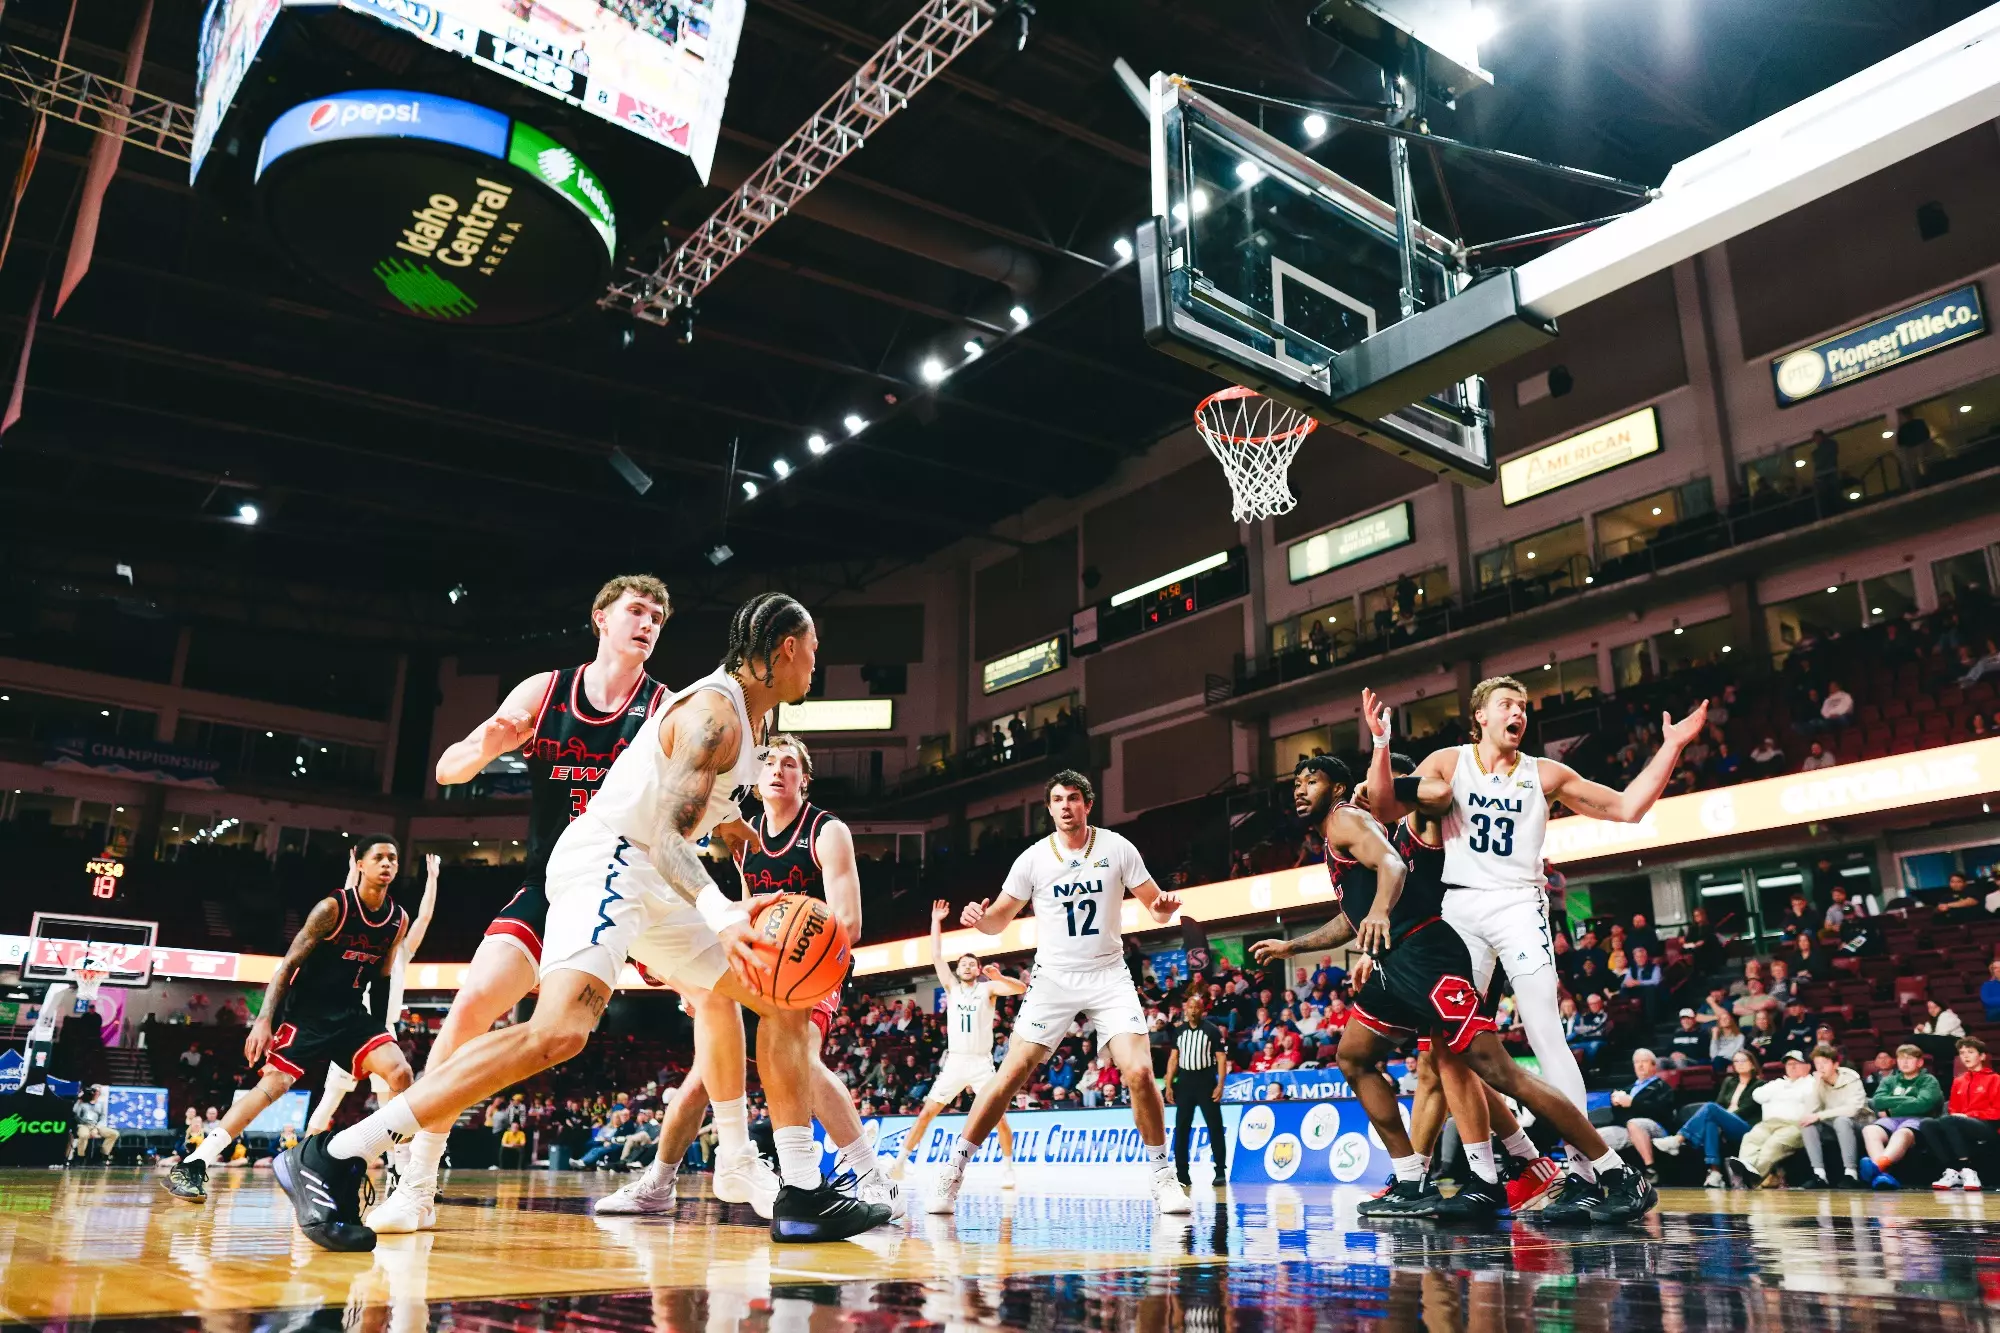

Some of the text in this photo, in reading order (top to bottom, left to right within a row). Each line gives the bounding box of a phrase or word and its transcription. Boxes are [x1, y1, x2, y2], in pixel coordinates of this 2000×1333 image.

[492, 37, 575, 92] 14:58
[598, 91, 608, 103] 8
[340, 101, 419, 127] pepsi
[577, 168, 611, 222] Idaho
[395, 193, 459, 257] Idaho
[436, 177, 513, 267] Central
[479, 221, 523, 276] ARENA
[1151, 612, 1158, 623] 4
[91, 743, 220, 773] CHAMPIONSHIP
[549, 765, 610, 782] EW
[1467, 792, 1523, 813] NAU
[1469, 813, 1515, 857] 33
[92, 876, 116, 899] 18
[1053, 879, 1103, 898] NAU
[1062, 898, 1100, 937] 12
[787, 902, 829, 964] Wilson
[11, 944, 21, 957] 8
[960, 1013, 971, 1033] 11
[20, 1121, 66, 1134] ICCU
